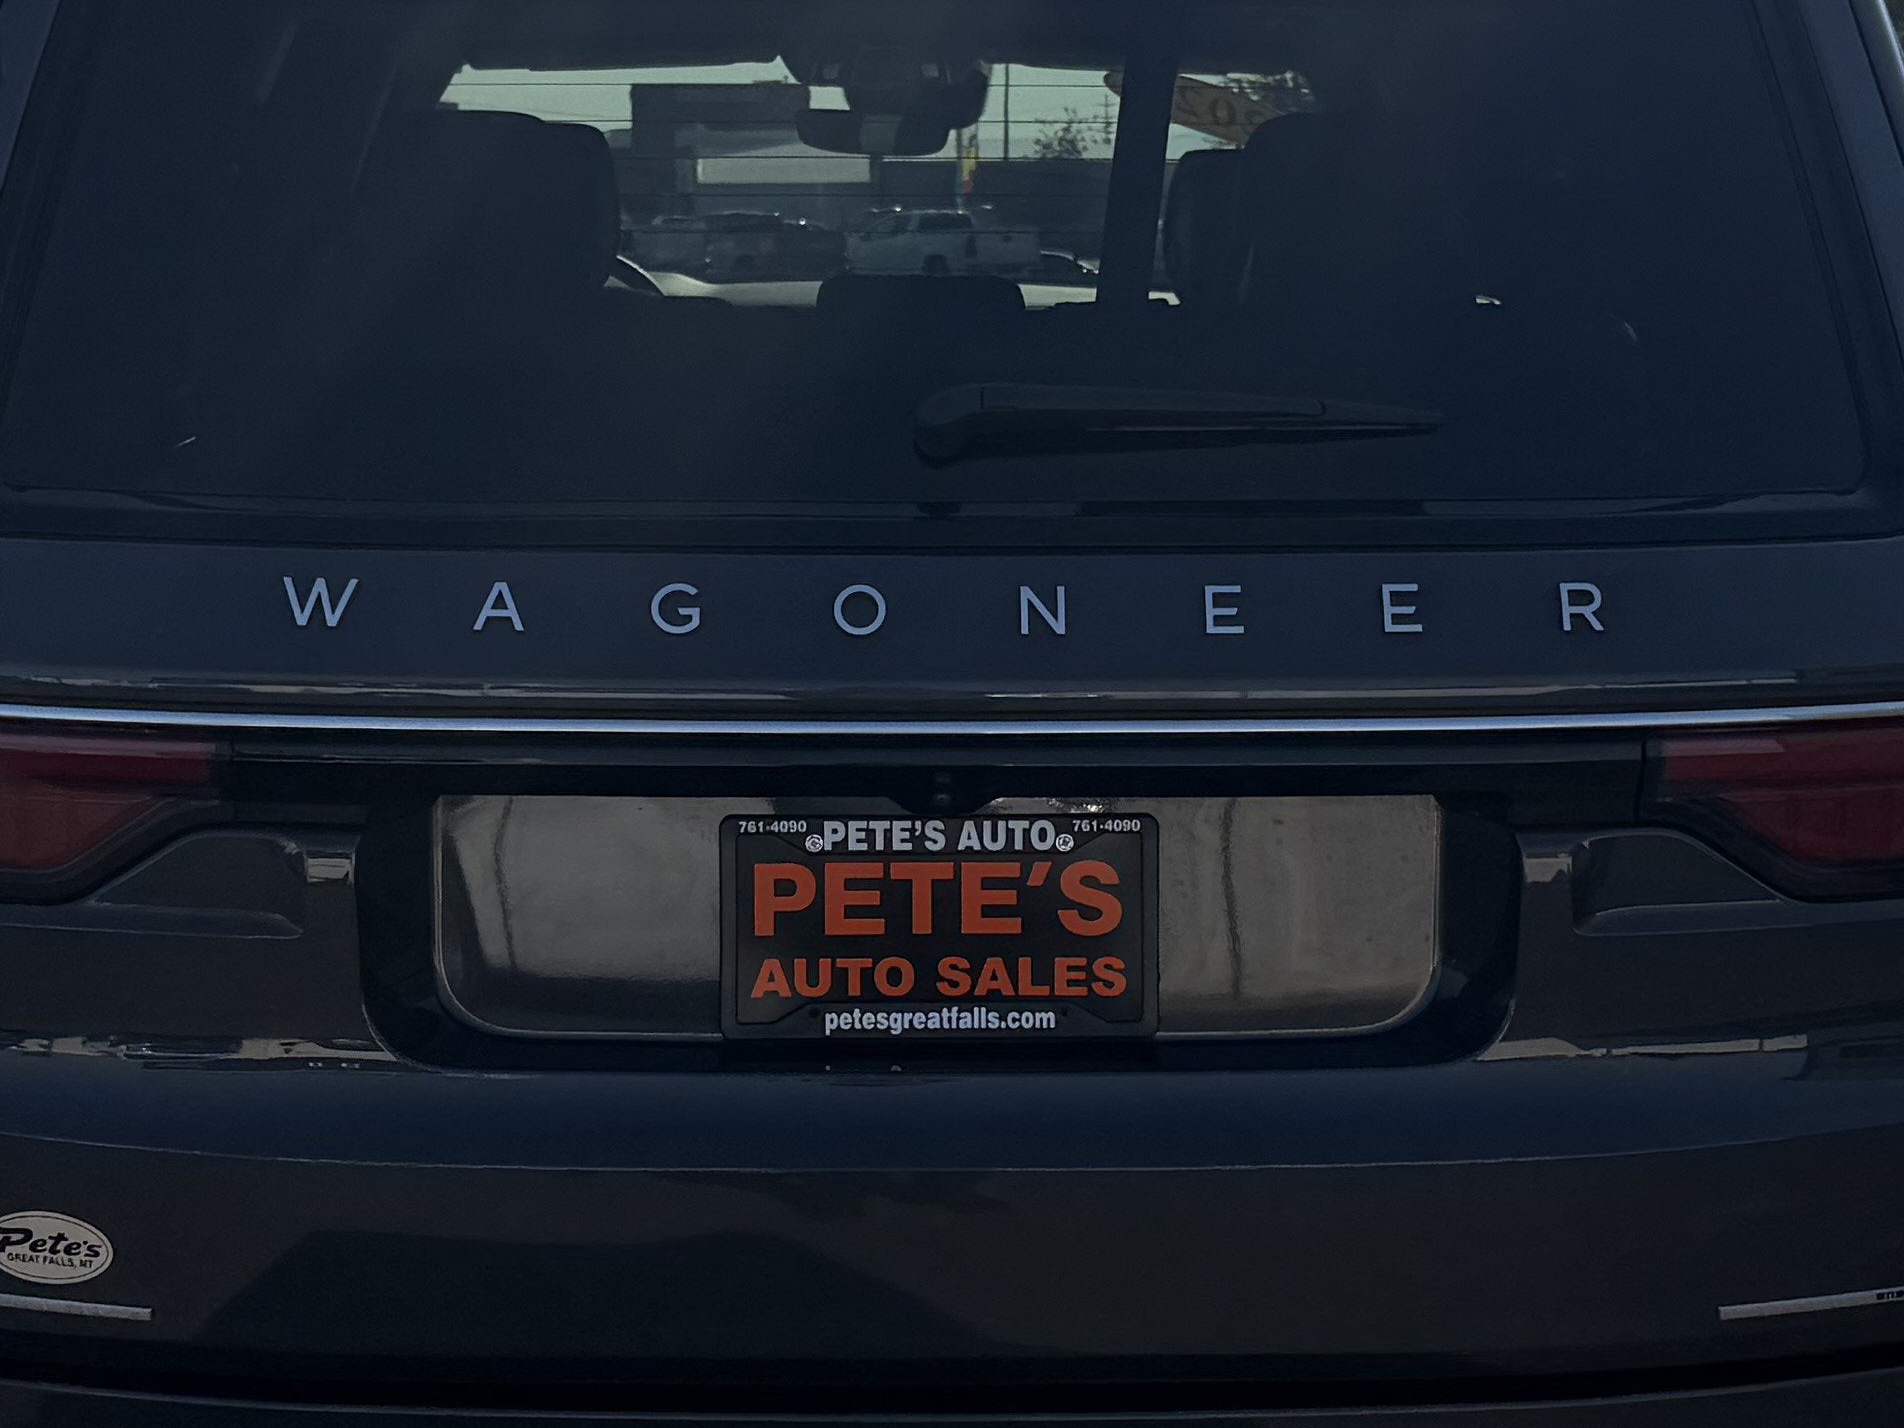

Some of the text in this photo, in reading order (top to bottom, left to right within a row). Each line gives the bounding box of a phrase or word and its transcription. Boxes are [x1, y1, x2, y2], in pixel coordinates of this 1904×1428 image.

[283, 576, 1604, 636] WAGONEER
[823, 820, 1056, 851] PETE'S AUTO
[754, 859, 1123, 937] PETE'S
[750, 956, 1127, 998] AUTO SALES
[825, 1006, 1056, 1036] petesgreatfalls.com
[7, 1252, 40, 1264] GREAT
[79, 1259, 94, 1269] MT
